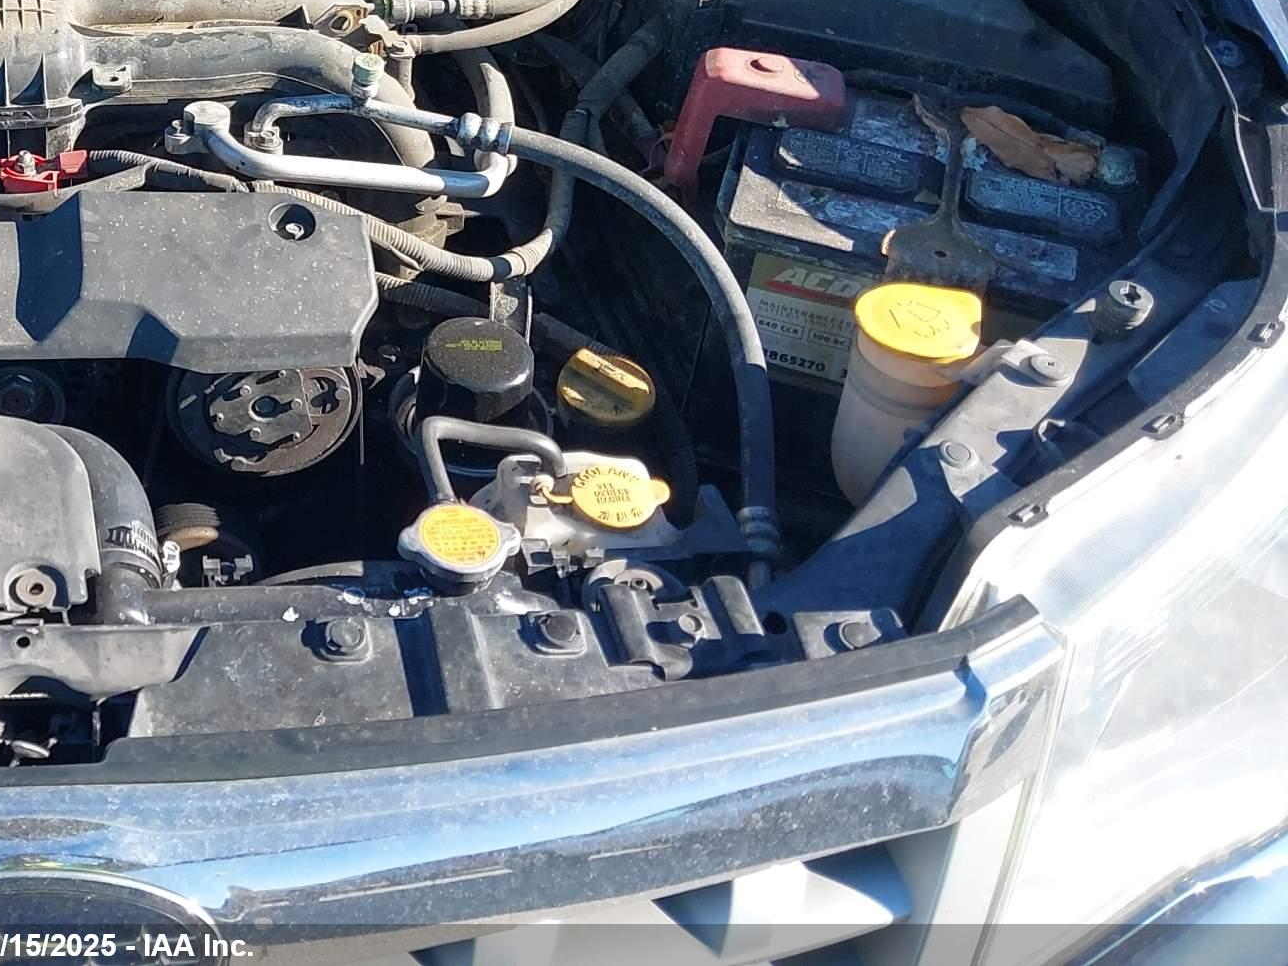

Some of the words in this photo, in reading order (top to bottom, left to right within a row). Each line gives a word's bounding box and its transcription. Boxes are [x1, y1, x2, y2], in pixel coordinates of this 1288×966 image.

[759, 299, 835, 324] MAINTENANCE
[758, 319, 778, 330] 640
[780, 324, 799, 335] CCA
